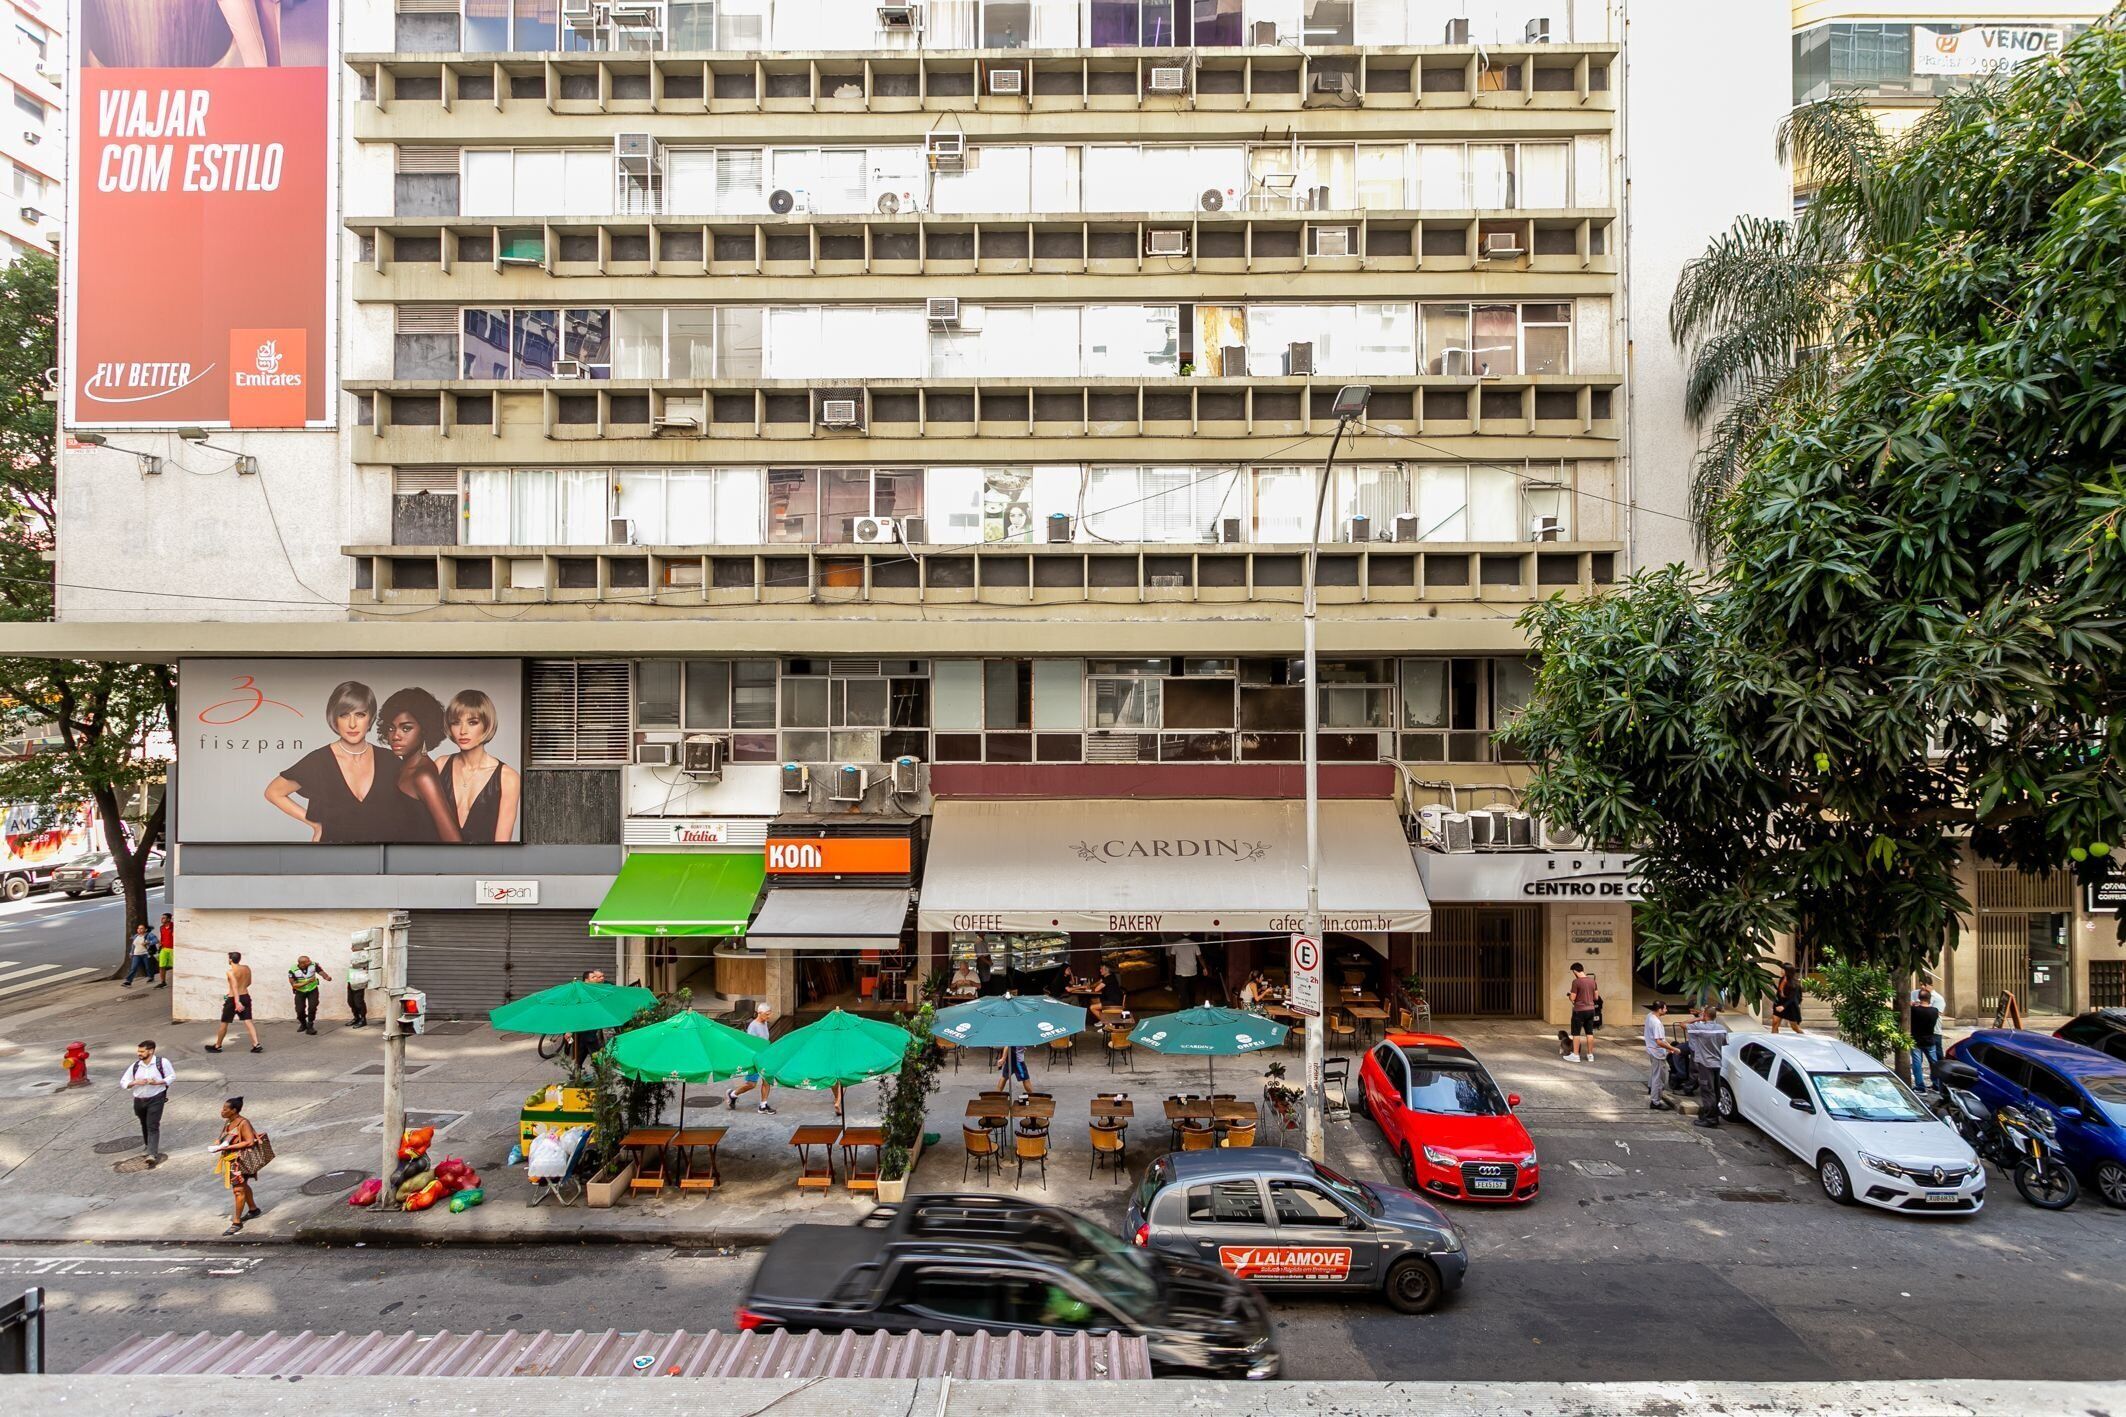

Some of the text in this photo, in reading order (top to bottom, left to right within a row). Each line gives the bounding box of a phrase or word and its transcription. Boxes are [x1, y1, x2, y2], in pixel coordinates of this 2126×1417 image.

[1981, 30, 2058, 51] VENDE
[98, 90, 210, 138] VIAJAR
[98, 142, 284, 192] COM ESTILO
[95, 363, 191, 387] FLY BETTER
[235, 372, 302, 387] Emirates
[199, 733, 304, 754] fiszpan
[682, 830, 719, 842] Itália
[1103, 839, 1240, 858] CARDIN
[1523, 882, 1596, 896] CENTRO
[1600, 882, 1623, 896] DE
[953, 914, 1003, 931] COFFEE
[1109, 915, 1163, 931] BAKERY
[1269, 915, 1392, 931] cafecdin.com.br
[1302, 946, 1311, 964] E
[1586, 947, 1600, 955] 44
[1310, 976, 1319, 985] 2h
[943, 1028, 967, 1039] ORFEU
[1040, 1027, 1067, 1038] ORFEU
[1140, 1036, 1161, 1047] ORFEU
[1237, 1040, 1266, 1050] ORFEU
[1255, 1252, 1345, 1266] LALAMOVE
